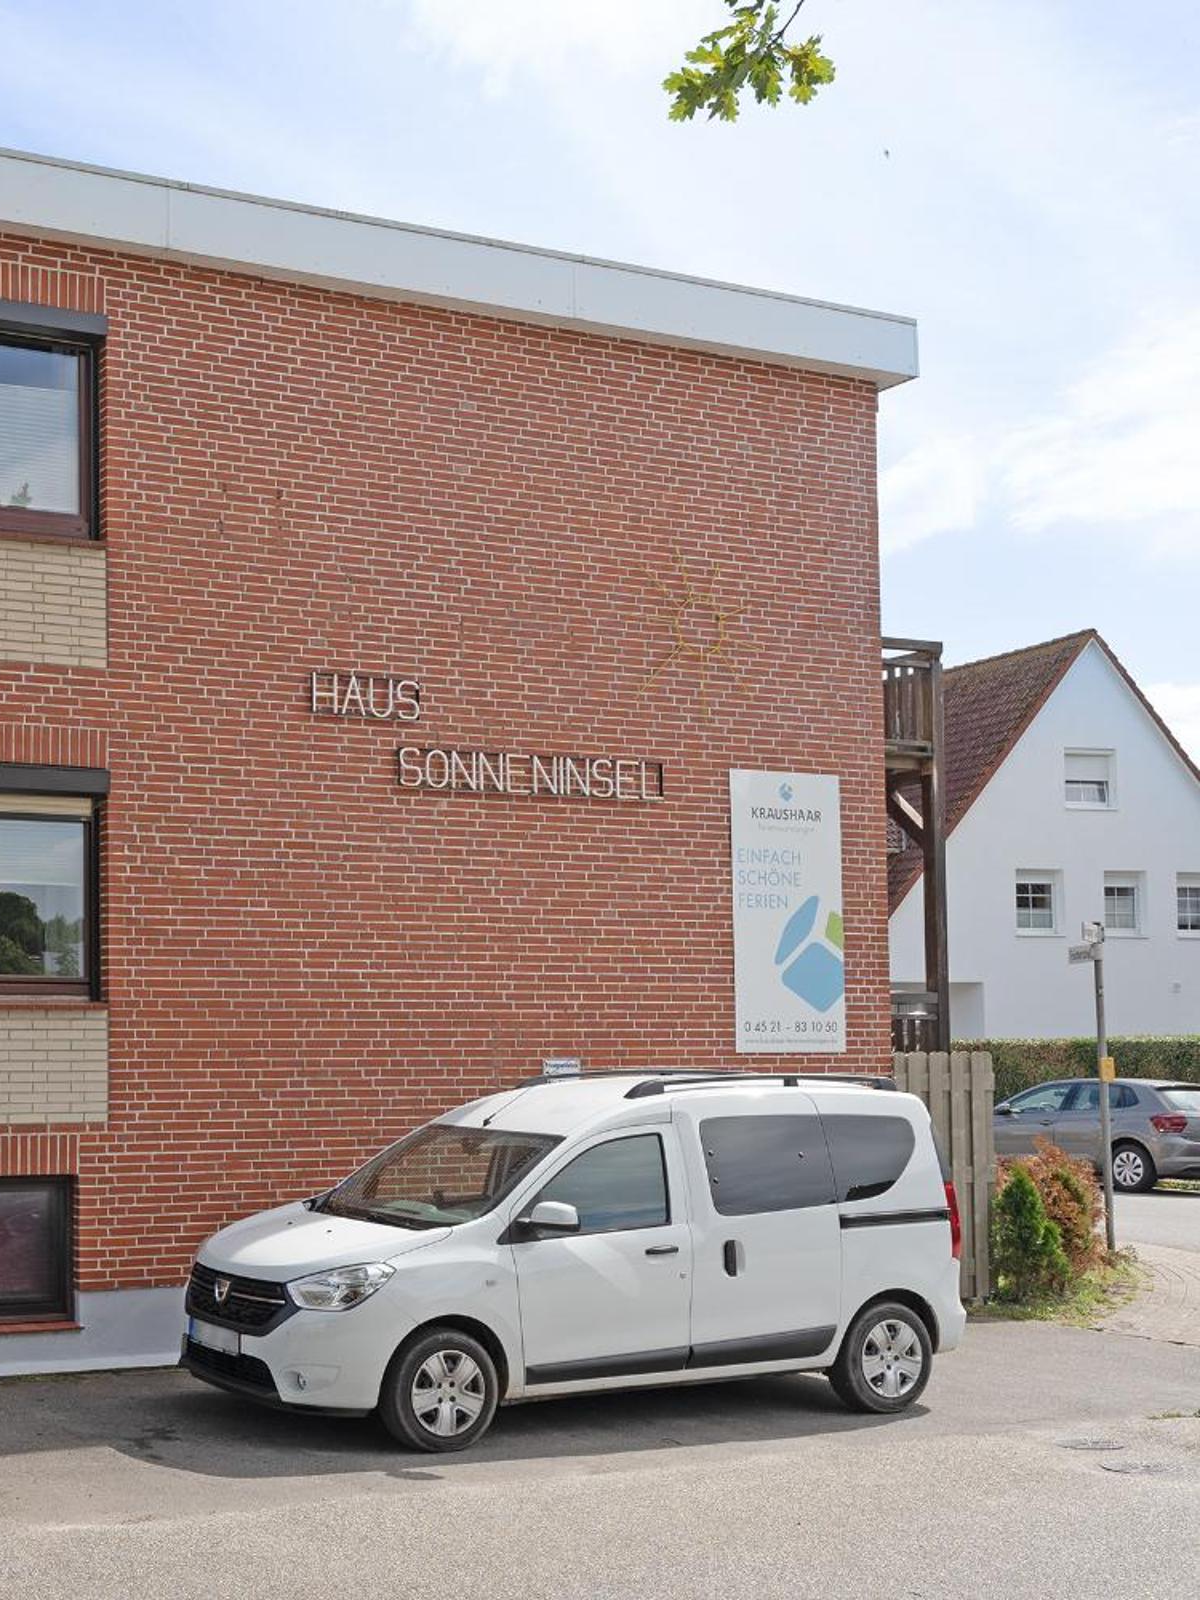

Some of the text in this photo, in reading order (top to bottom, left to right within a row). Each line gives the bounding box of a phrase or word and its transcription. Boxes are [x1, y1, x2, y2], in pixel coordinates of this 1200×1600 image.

[311, 671, 420, 720] HAUS
[398, 746, 665, 800] SONNENINSEL
[751, 807, 822, 823] KRAUSHAAR
[737, 848, 801, 866] EINFACH
[738, 867, 802, 887] SCHÖNE
[738, 893, 788, 909] FERIEN
[794, 1020, 808, 1033] 83
